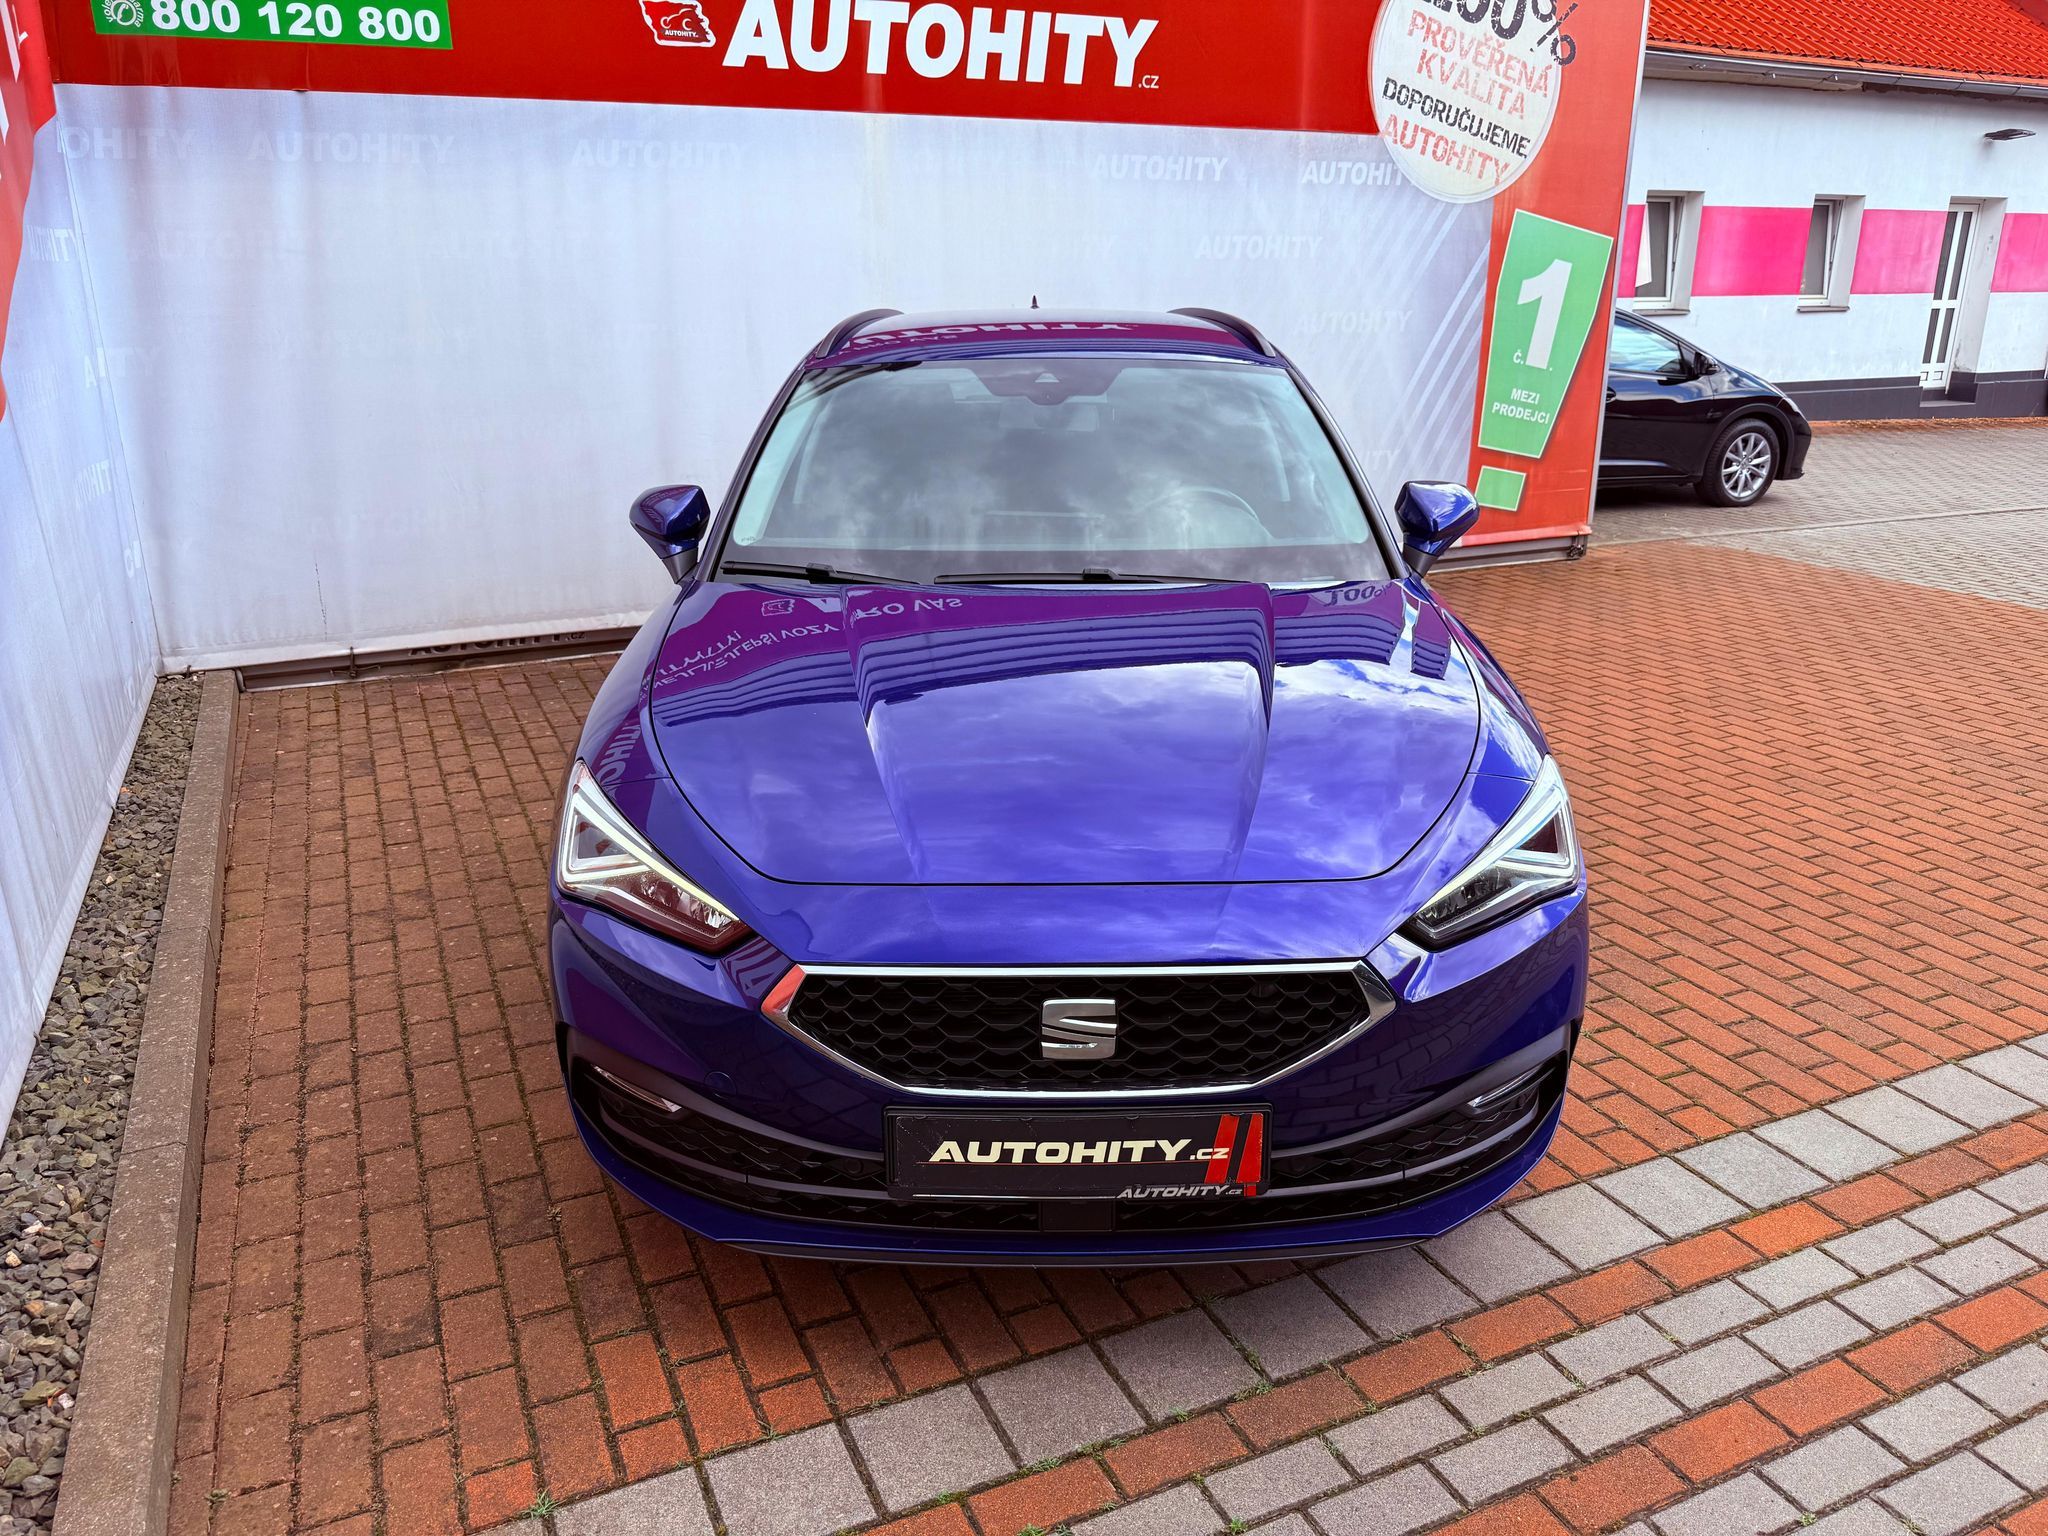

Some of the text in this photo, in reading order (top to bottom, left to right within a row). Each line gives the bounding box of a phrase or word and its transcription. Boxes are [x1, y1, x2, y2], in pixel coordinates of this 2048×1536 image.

[151, 0, 441, 43] 800 120 800
[1407, 10, 1553, 98] PROVĚŘENÁ
[1416, 48, 1525, 120] KVALITA
[1381, 77, 1532, 159] DOPORUČUJEME
[246, 131, 456, 164] AUTOHITY
[1378, 114, 1512, 187] AUTOHITY
[1091, 153, 1229, 182] AUTOHITY
[1301, 160, 1403, 186] AUTOHI
[1195, 234, 1323, 260] AUTOHITY
[1510, 387, 1541, 405] MEZI
[1491, 401, 1551, 425] PRODEJCI
